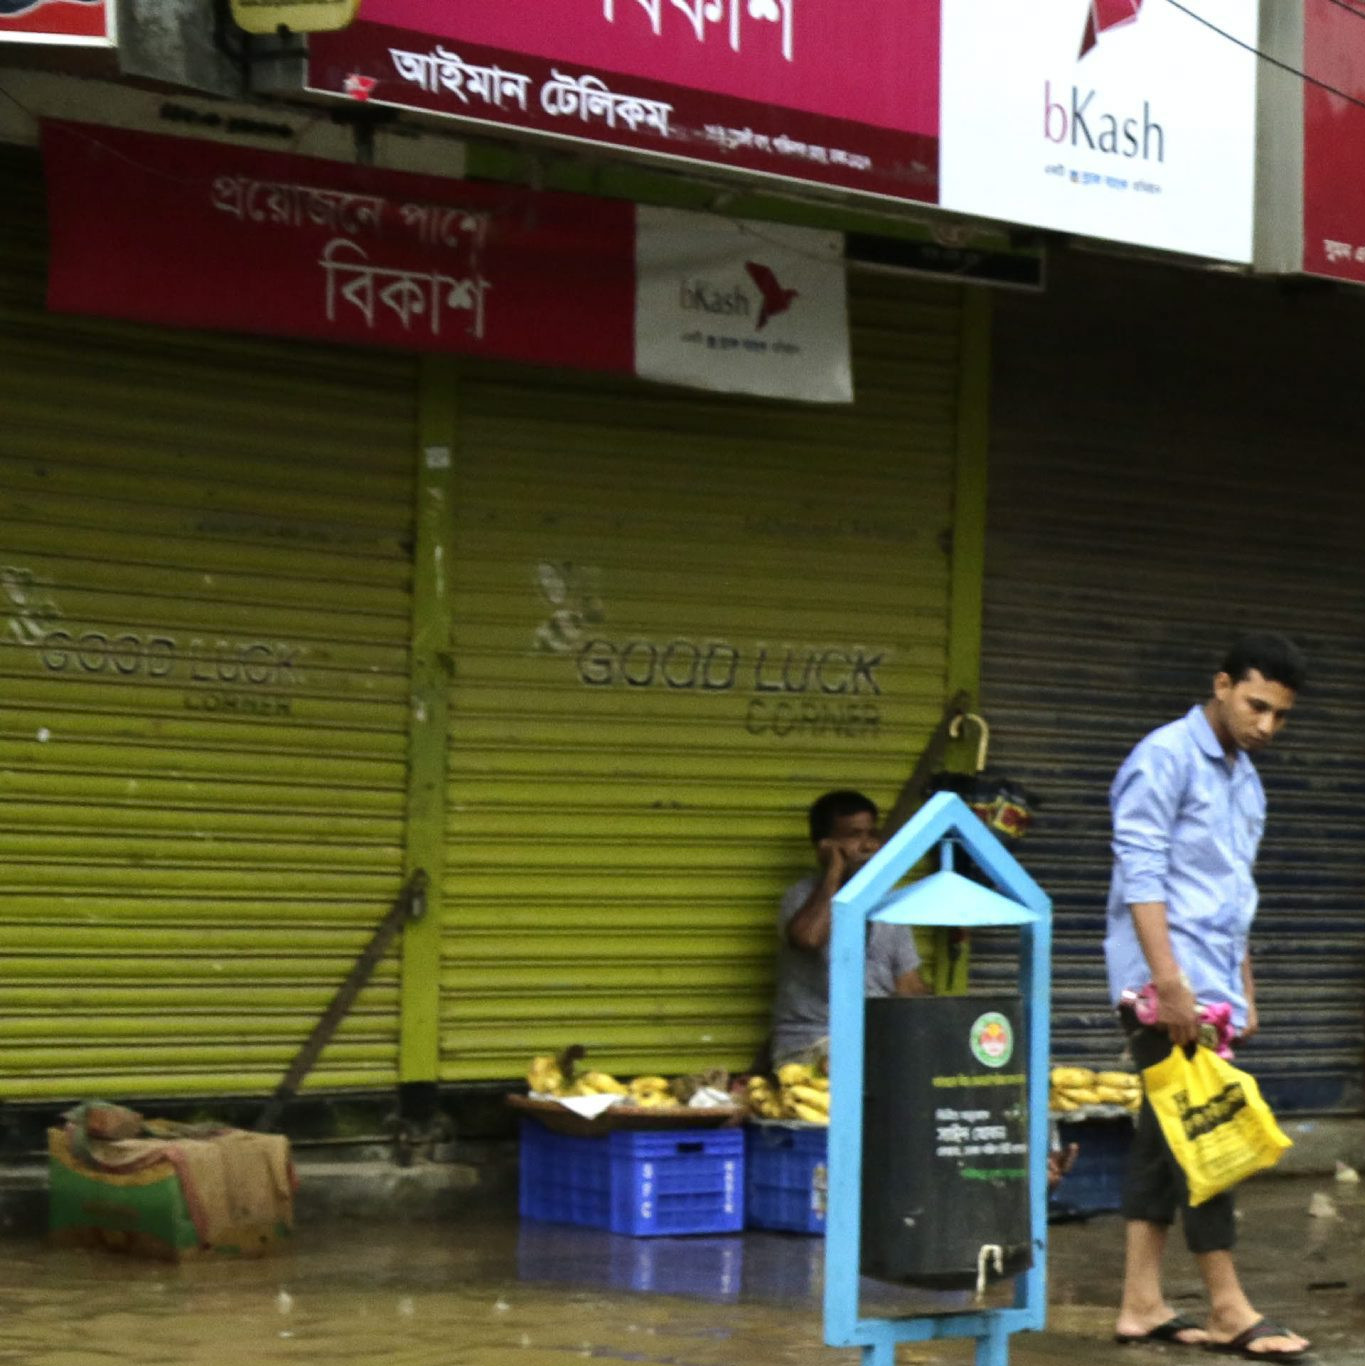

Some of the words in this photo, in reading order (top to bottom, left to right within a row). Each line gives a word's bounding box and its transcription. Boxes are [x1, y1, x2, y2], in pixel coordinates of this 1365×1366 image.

[389, 45, 532, 111] আইমান
[541, 67, 674, 137] টেলিকম
[1044, 79, 1164, 163] bKash
[211, 175, 385, 238] প্রয়োজনে
[317, 238, 491, 340] বিকাশ
[42, 631, 175, 676] GOOD
[191, 639, 304, 684] LUCK
[577, 638, 740, 691] GOOD
[753, 643, 886, 697] LUCK
[744, 699, 881, 738] CORNER
